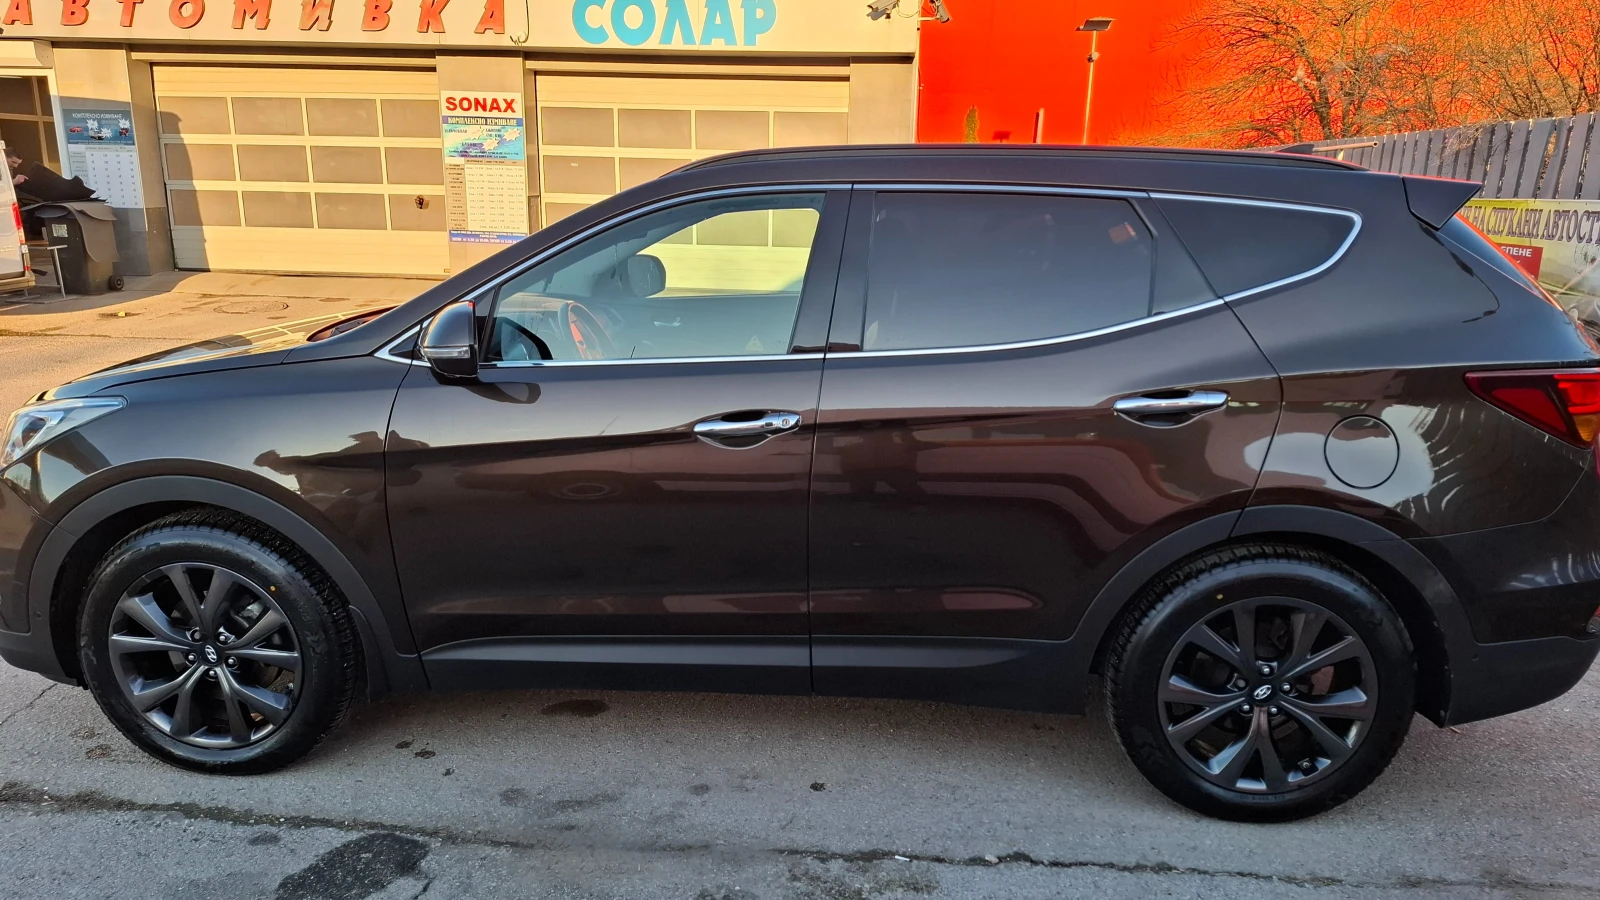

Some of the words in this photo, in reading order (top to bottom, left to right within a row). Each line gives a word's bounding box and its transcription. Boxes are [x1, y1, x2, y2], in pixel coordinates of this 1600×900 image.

[3, 0, 505, 34] АВТОМИВКА
[572, 0, 776, 47] СОЛАР
[445, 96, 516, 113] SONAX
[448, 117, 485, 125] КОМПЛЕКСНО
